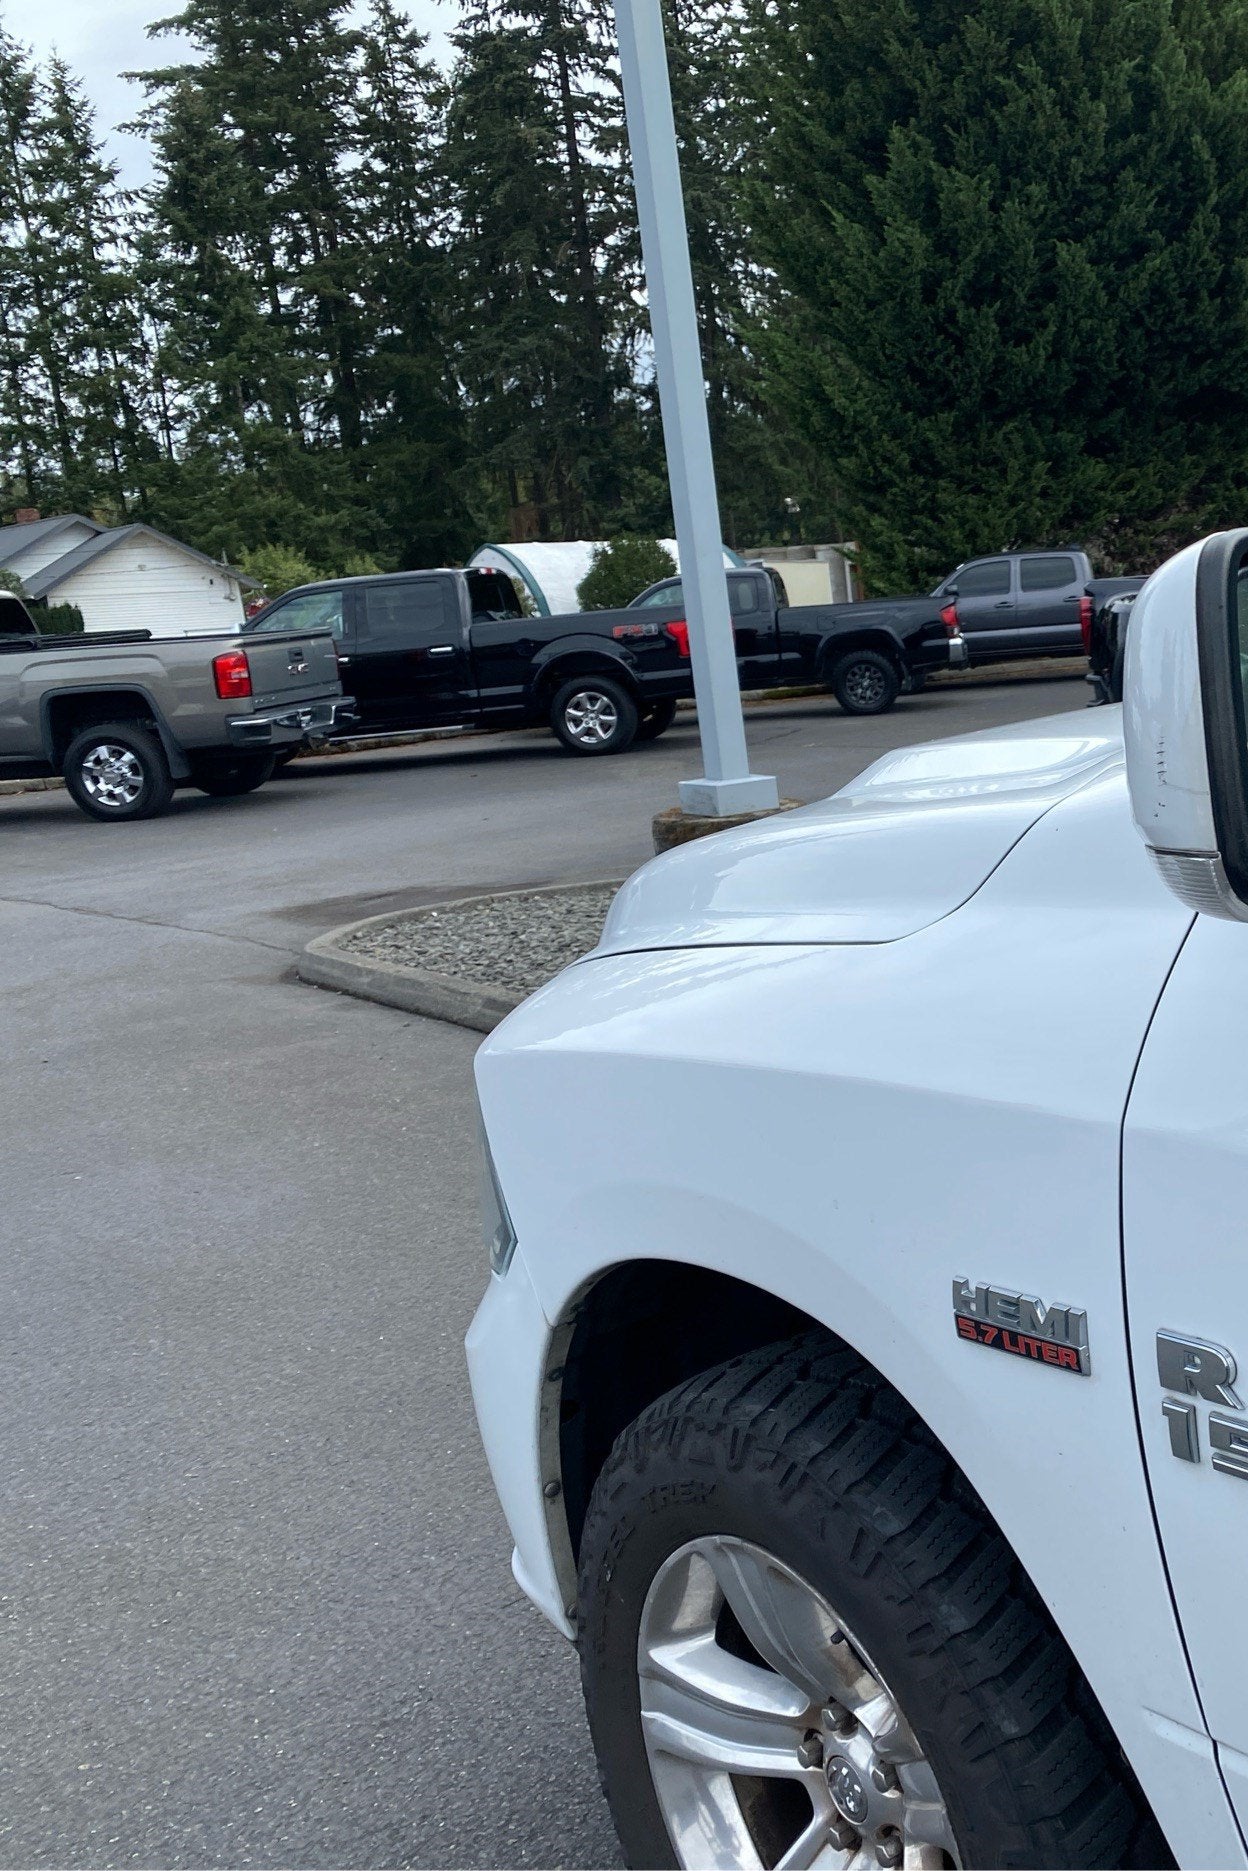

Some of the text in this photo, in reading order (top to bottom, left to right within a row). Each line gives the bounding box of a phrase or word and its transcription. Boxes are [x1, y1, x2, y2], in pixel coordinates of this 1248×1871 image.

[952, 1275, 1088, 1347] HEMI
[957, 1317, 1080, 1371] 5.7 LITER
